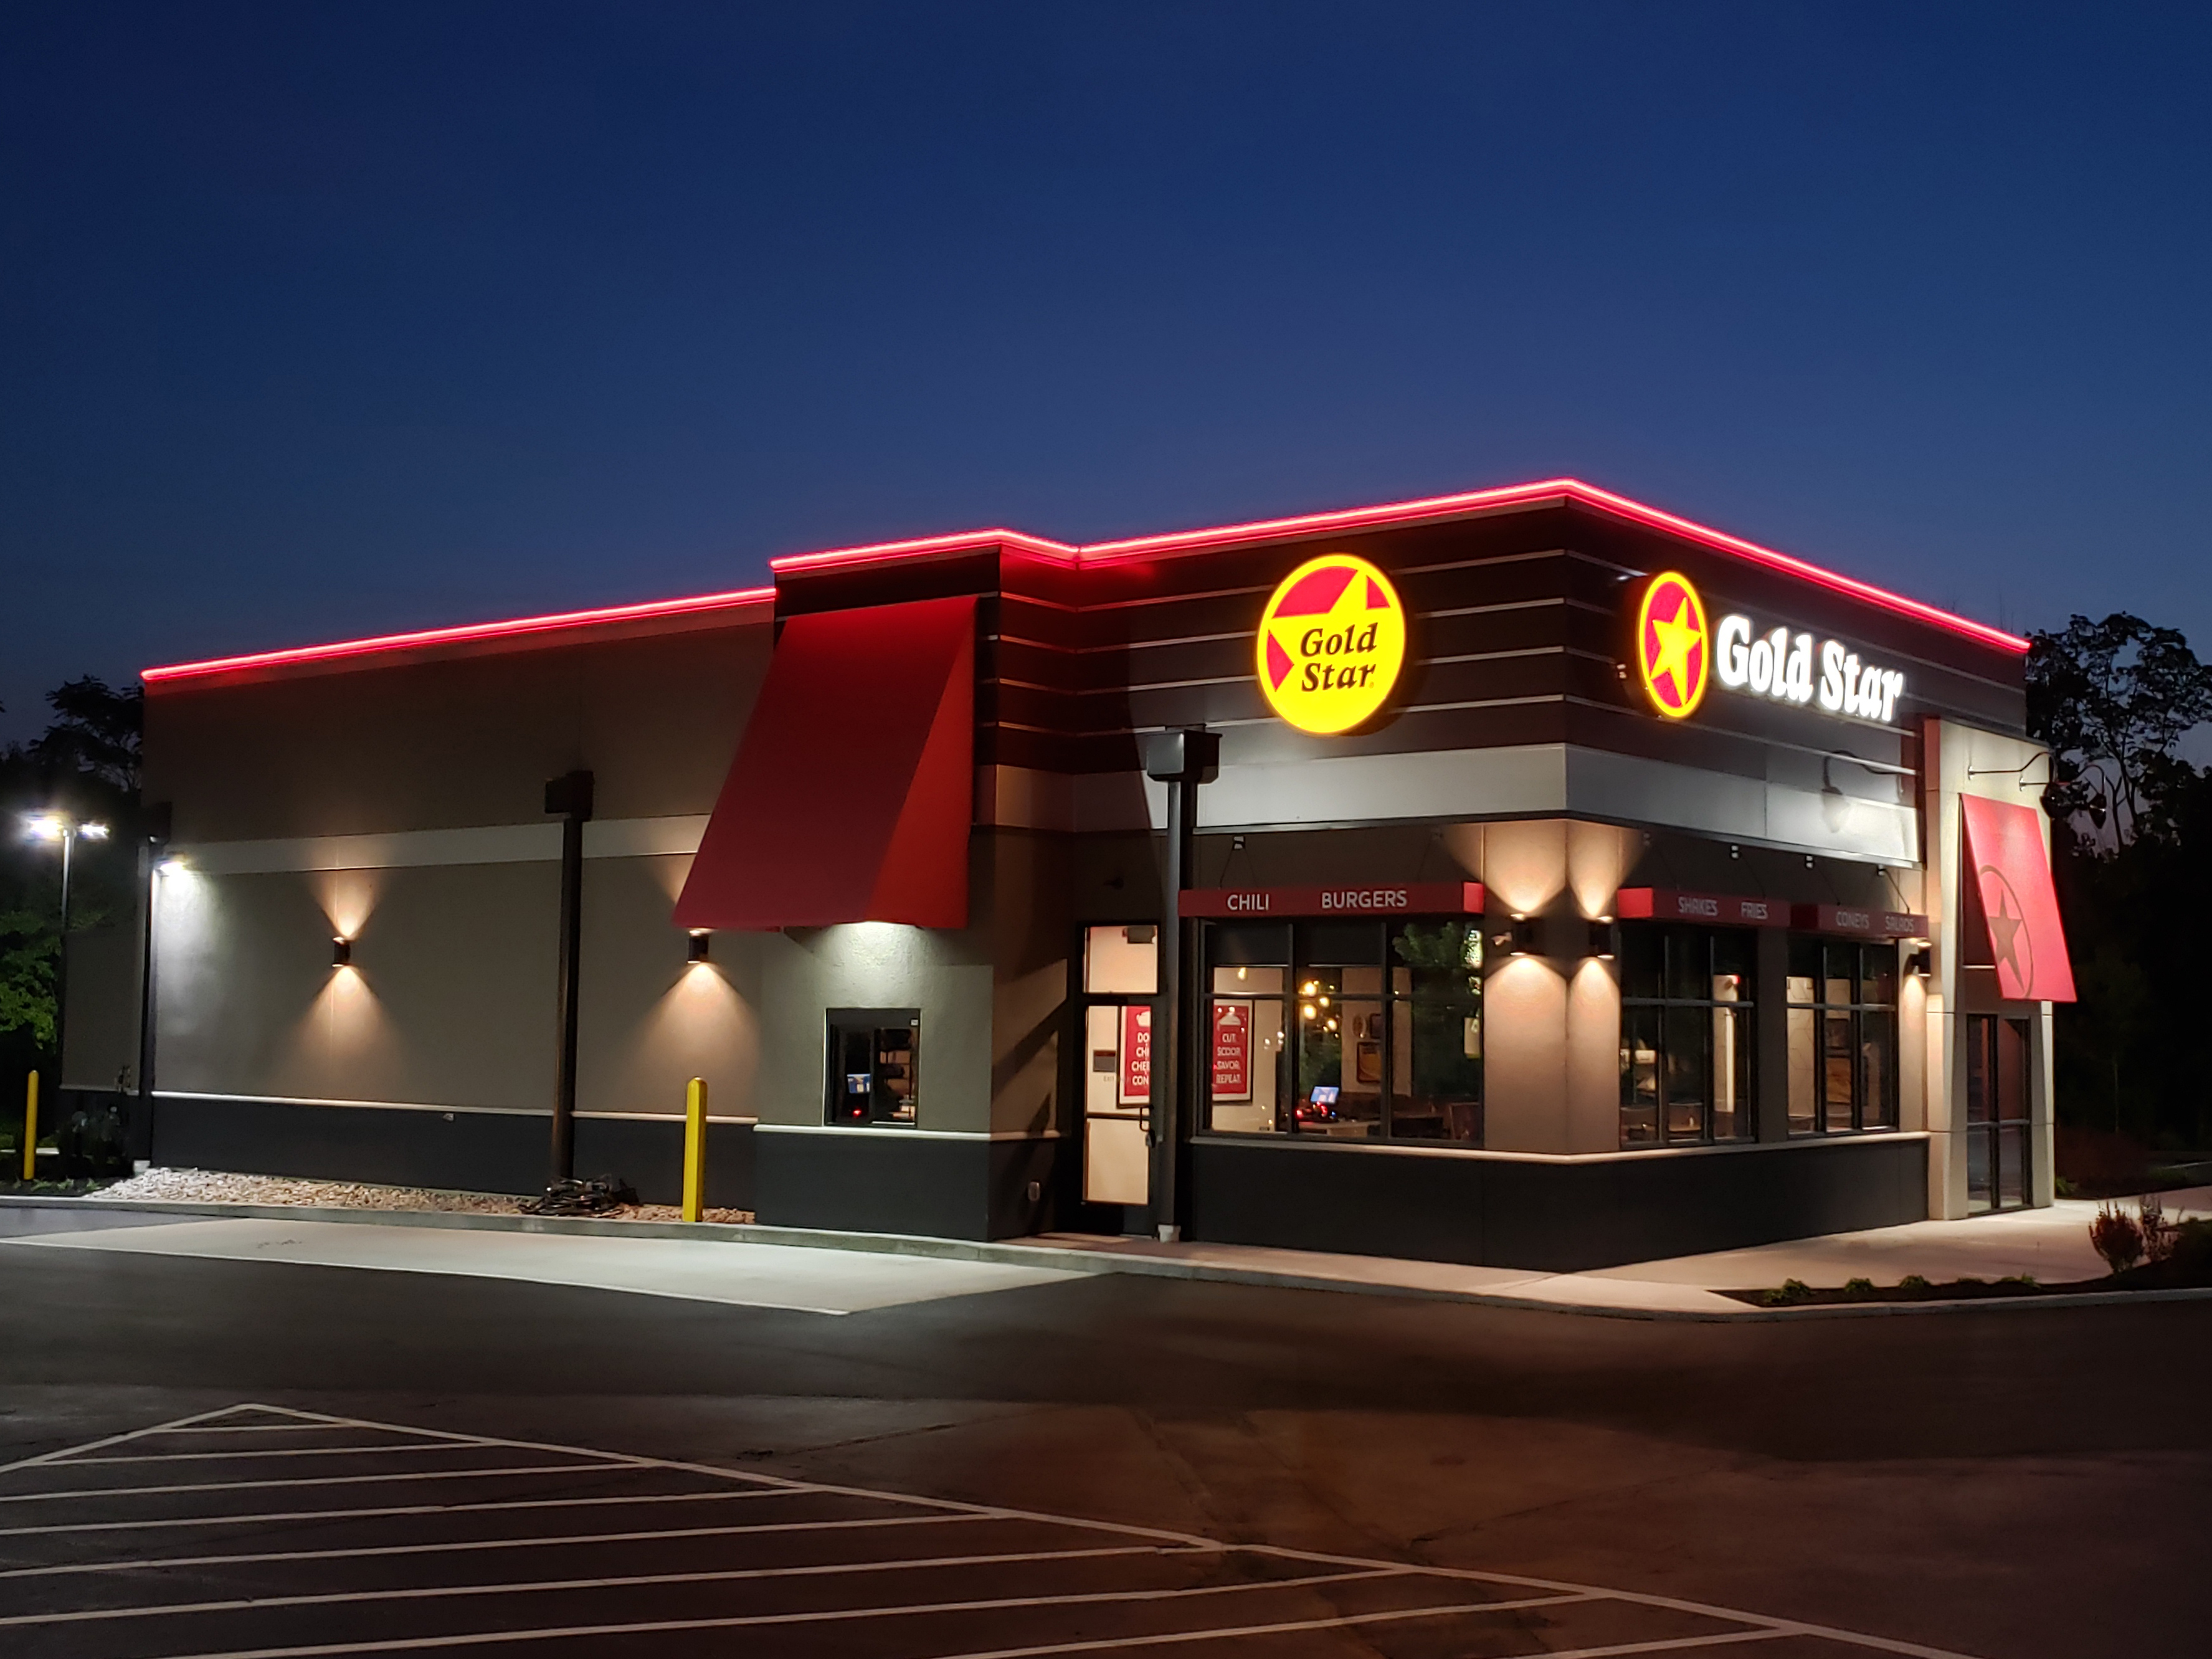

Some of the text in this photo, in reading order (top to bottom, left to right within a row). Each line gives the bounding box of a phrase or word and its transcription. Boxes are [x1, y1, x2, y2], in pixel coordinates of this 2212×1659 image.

[1300, 622, 1379, 658] Gold
[1301, 662, 1377, 692] Star
[1717, 614, 1903, 723] Gold Star
[1227, 890, 1407, 911] CHILI BURGERS
[1678, 896, 1768, 920] SHAKES FRIES
[1836, 911, 1914, 933] CONEYS SALADS
[1137, 1032, 1149, 1043] DO
[1132, 1075, 1149, 1086] CON
